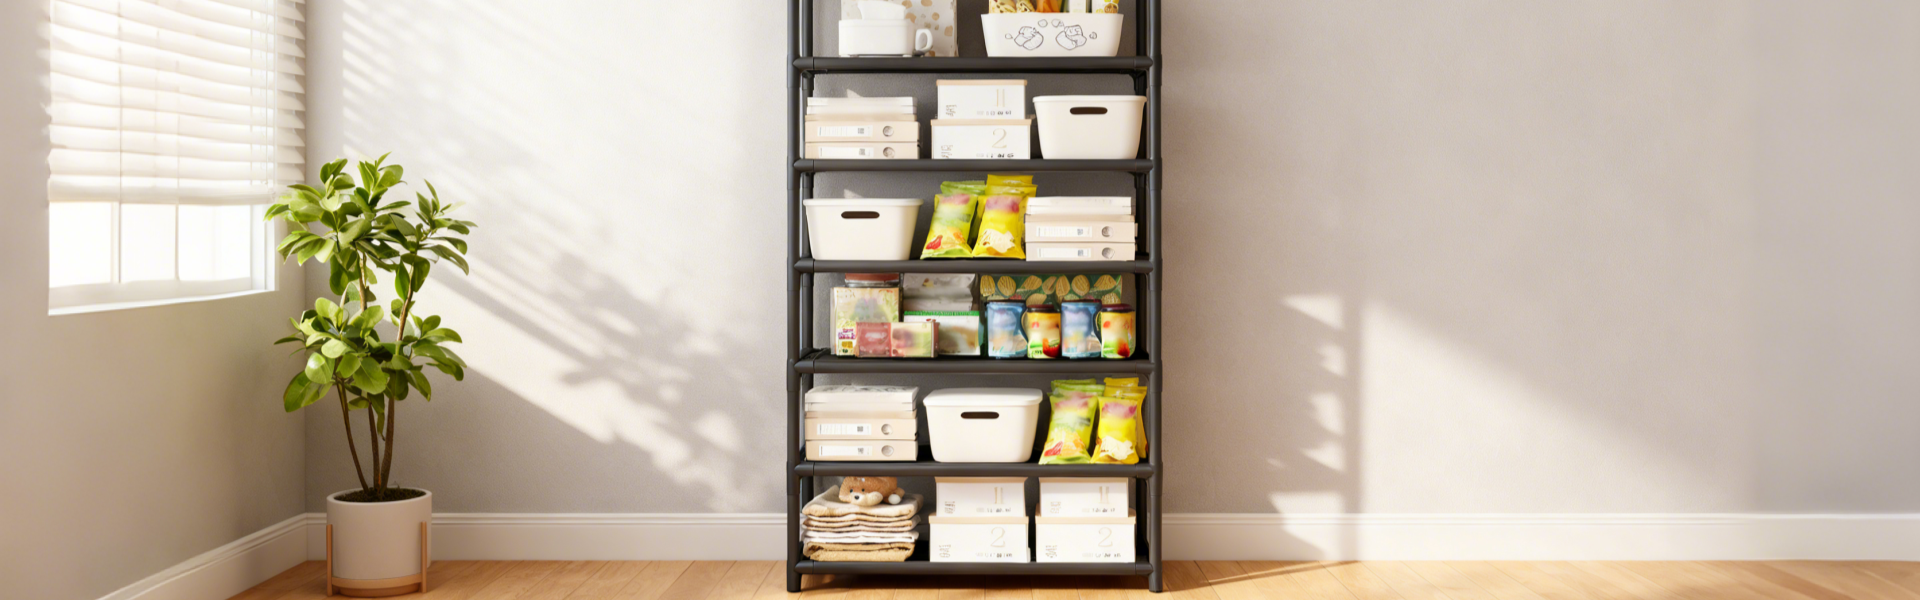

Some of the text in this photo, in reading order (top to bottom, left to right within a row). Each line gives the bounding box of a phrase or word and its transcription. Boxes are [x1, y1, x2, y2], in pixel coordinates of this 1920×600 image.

[991, 127, 1007, 149] 2
[990, 526, 1006, 548] 2
[1098, 526, 1113, 548] 2
